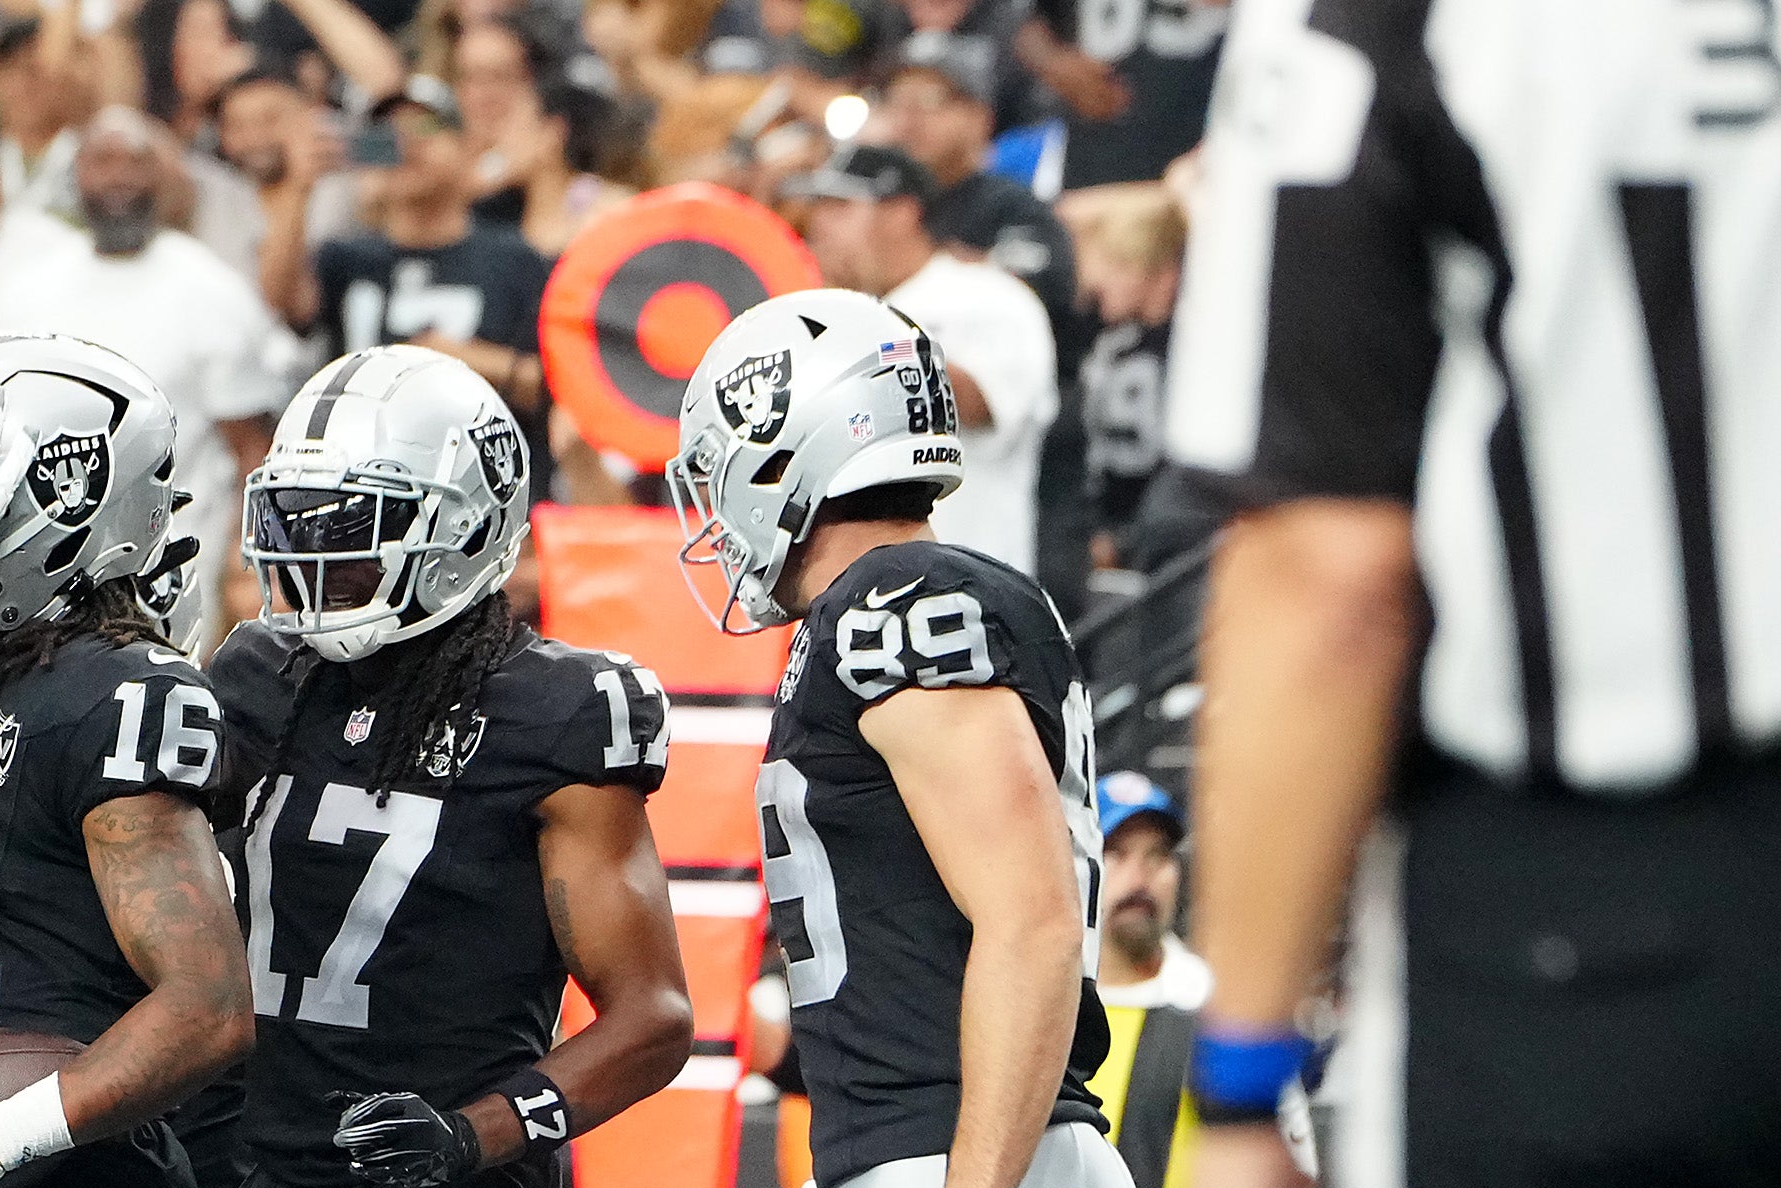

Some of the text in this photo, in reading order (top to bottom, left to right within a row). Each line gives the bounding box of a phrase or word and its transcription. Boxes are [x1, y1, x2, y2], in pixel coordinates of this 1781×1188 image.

[36, 437, 101, 461] AIDERS
[835, 590, 995, 700] 89
[102, 680, 225, 788] 16
[243, 774, 443, 1029] 17
[514, 1087, 569, 1141] 17
